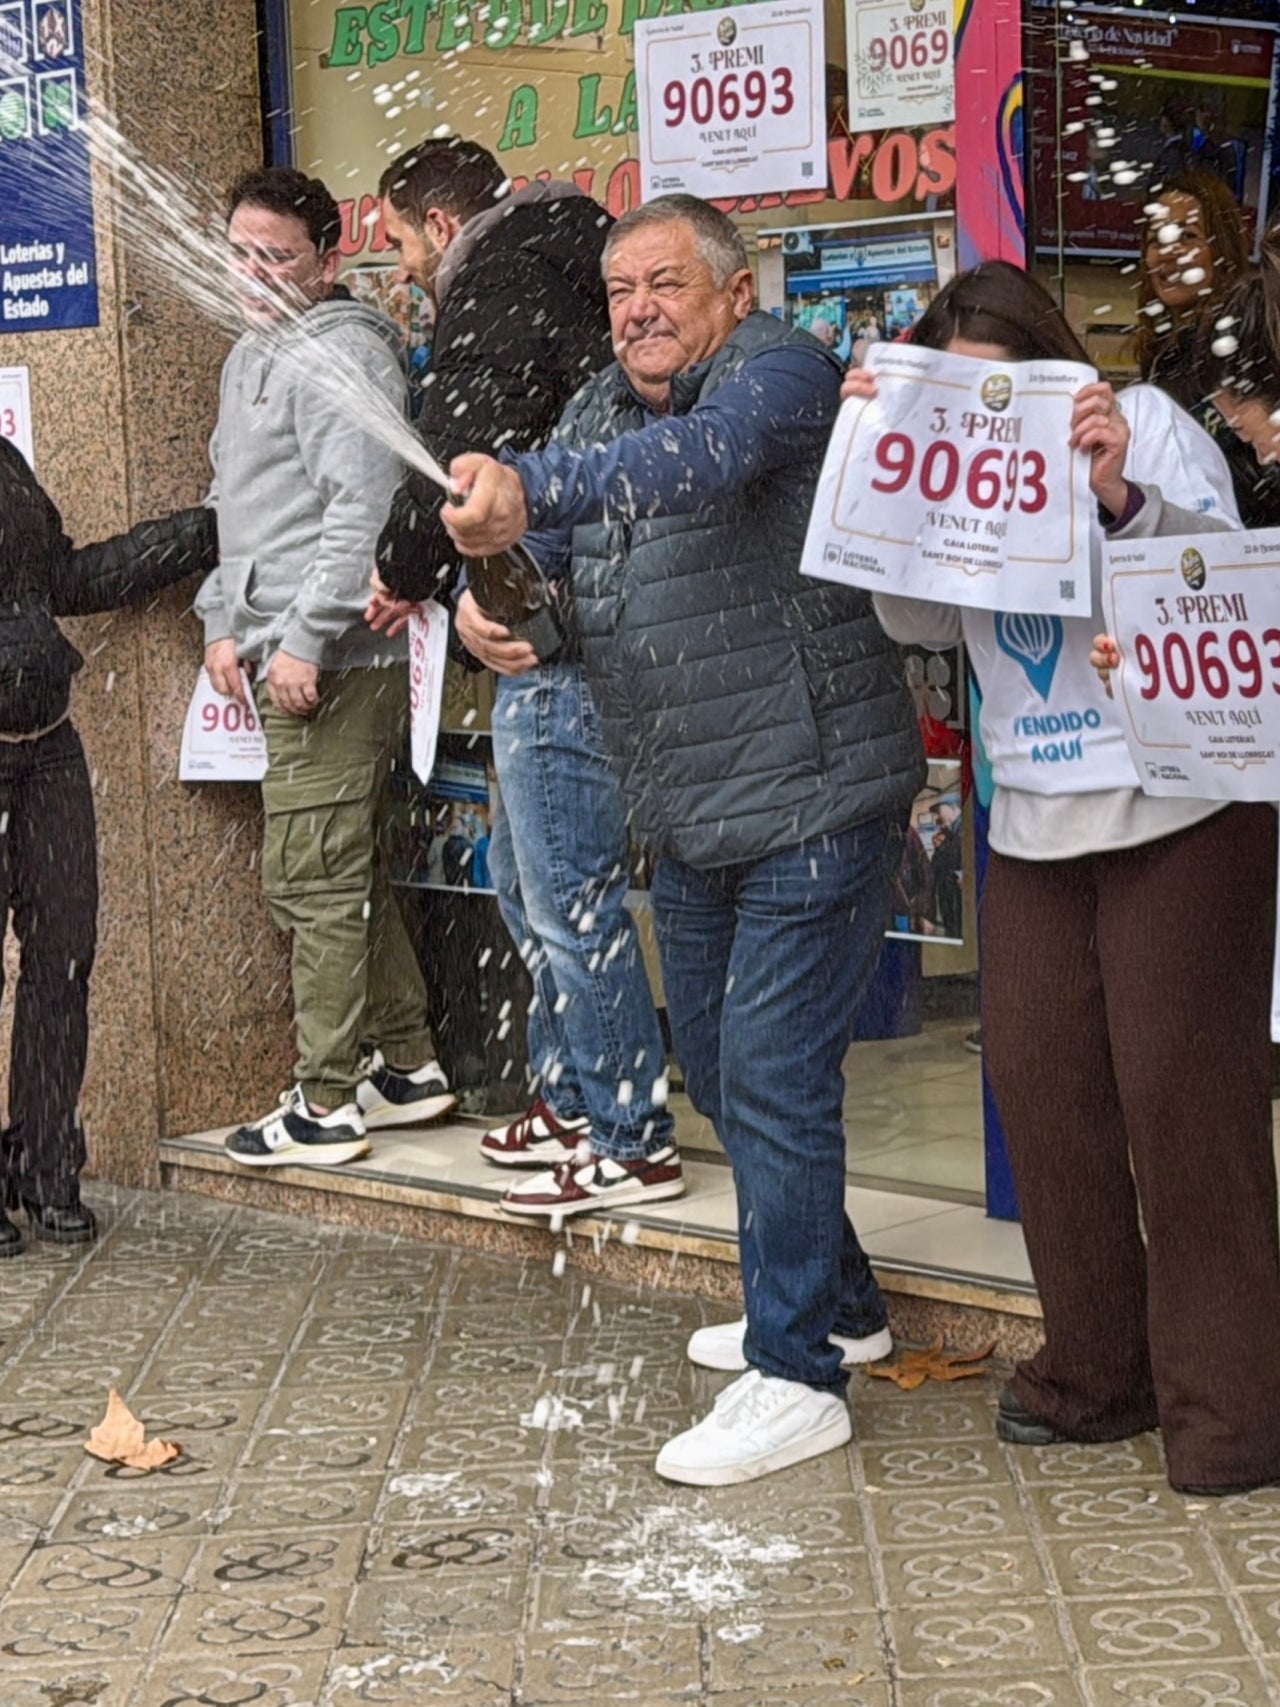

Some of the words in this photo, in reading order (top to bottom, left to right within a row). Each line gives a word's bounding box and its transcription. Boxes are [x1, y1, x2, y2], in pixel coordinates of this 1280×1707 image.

[903, 10, 946, 30] PREMI
[708, 44, 764, 71] PREMI
[869, 29, 949, 72] 9069
[663, 67, 794, 127] 90693
[497, 84, 538, 151] A
[3, 267, 63, 295] Apuestas
[67, 263, 89, 285] del
[3, 295, 49, 319] Estado
[870, 432, 1048, 514] 90693
[926, 511, 982, 533] VENUT
[1176, 593, 1249, 625] PREMI
[1031, 733, 1083, 763] AQUÍ
